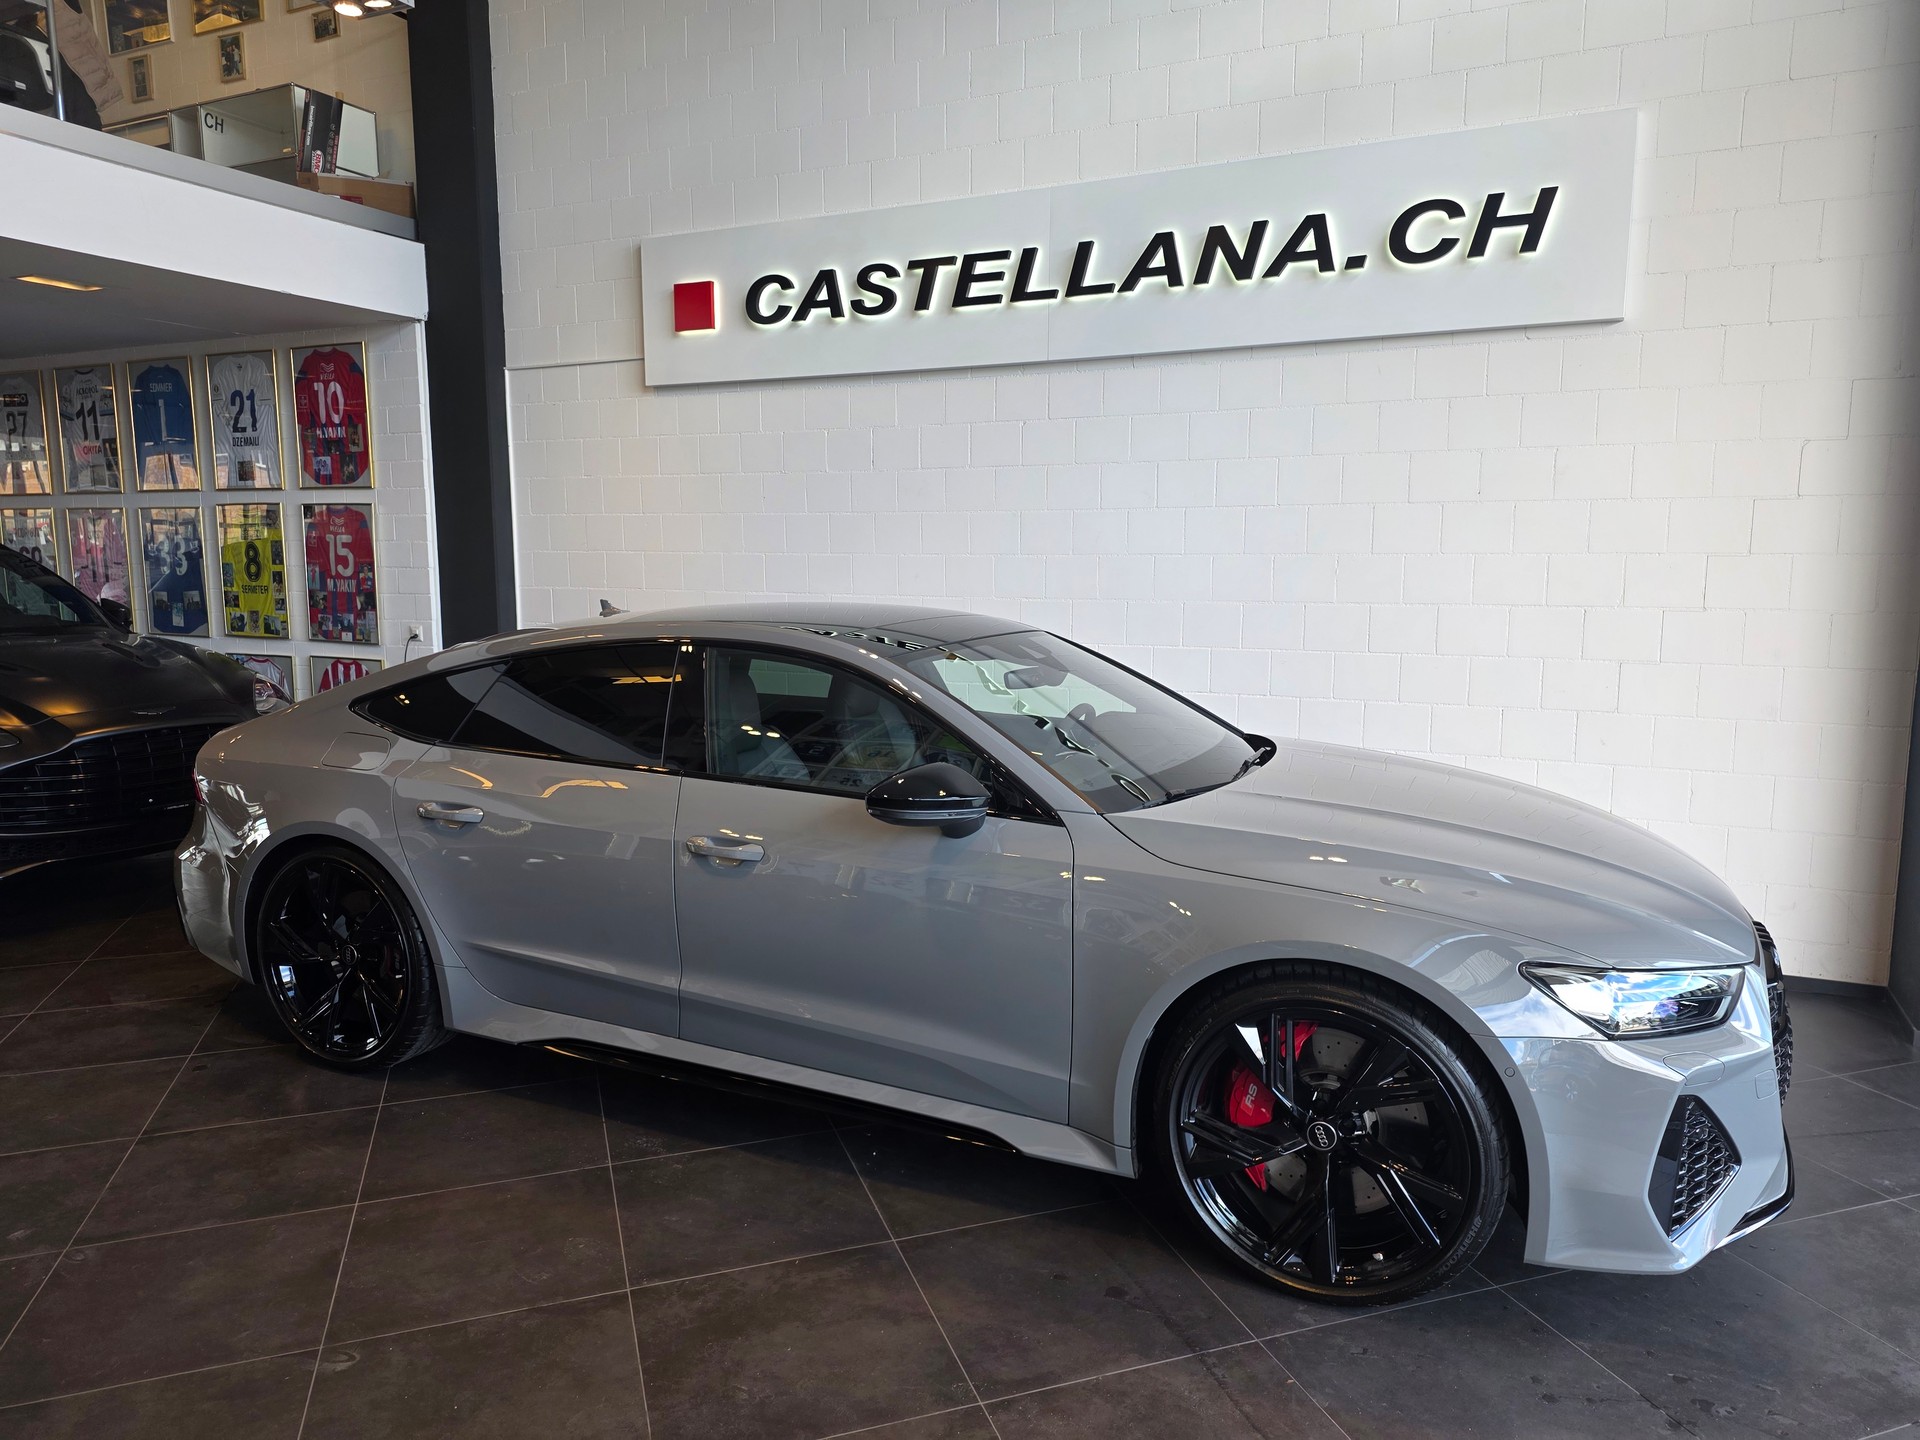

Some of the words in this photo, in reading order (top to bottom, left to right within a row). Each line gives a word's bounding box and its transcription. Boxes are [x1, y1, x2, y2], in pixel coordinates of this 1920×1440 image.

[204, 112, 224, 133] CH
[745, 186, 1559, 326] CASTELLANA.CH
[76, 400, 100, 442] 11
[230, 389, 257, 434] 21
[314, 381, 344, 424] 10
[244, 541, 262, 582] 8
[326, 534, 355, 577] 15
[1245, 1083, 1258, 1108] RS
